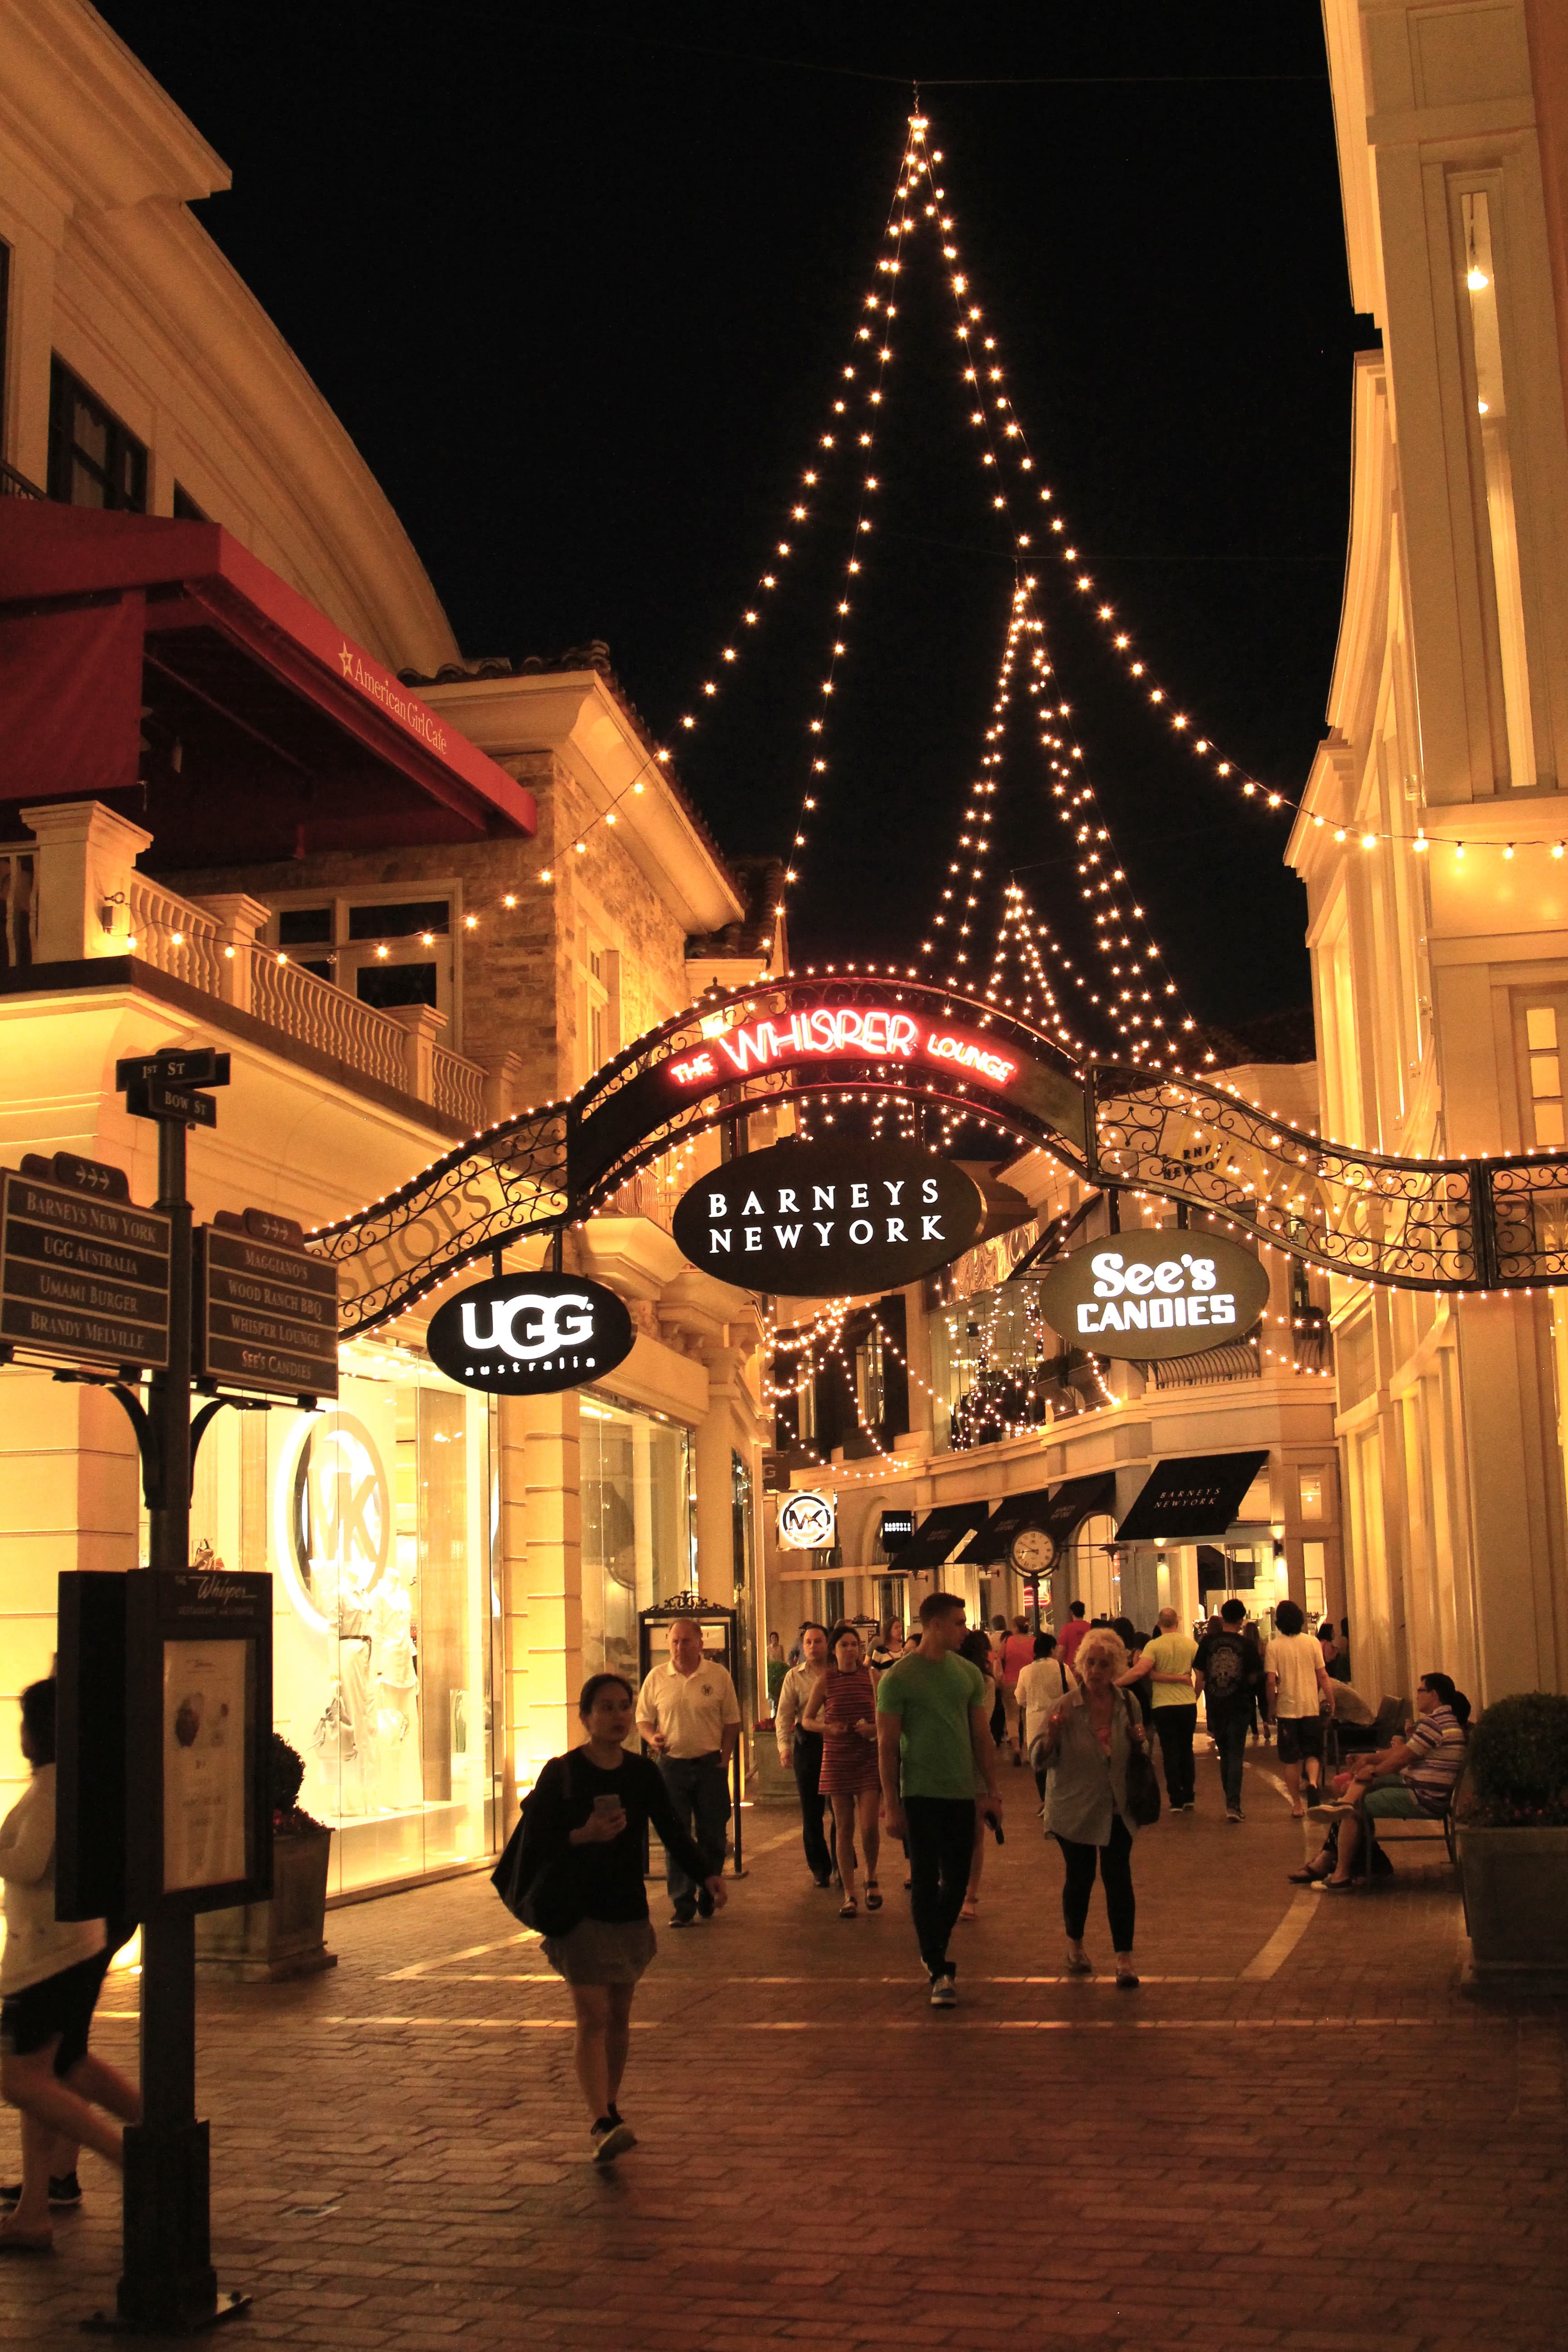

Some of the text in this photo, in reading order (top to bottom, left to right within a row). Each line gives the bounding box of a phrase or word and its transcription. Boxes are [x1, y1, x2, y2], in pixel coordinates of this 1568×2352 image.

[355, 658, 406, 721] American
[407, 702, 425, 738] Girl
[671, 1009, 1016, 1084] THE WHISPER LOUNGE
[167, 1062, 185, 1075] ST
[165, 1091, 206, 1115] BOW ST
[27, 1191, 157, 1243] BARNEYS NEW YORK
[708, 1179, 938, 1218] BARNEYS
[44, 1236, 138, 1274] UGG AUSTRALIA
[40, 1275, 138, 1313] UMAMI BURGER
[1091, 1253, 1217, 1298] See's
[228, 1280, 322, 1321] WOOD RANCH BBQ
[1077, 1294, 1235, 1333] CANDIES
[31, 1311, 145, 1349] BRANDY MELVILLE
[231, 1314, 319, 1348] WHISPER LOUNGE
[461, 1294, 594, 1360] UGG
[269, 1356, 311, 1380] CANDIES
[465, 1356, 595, 1376] australia
[1160, 1488, 1221, 1499] BARNEYS
[789, 1510, 823, 1529] MK
